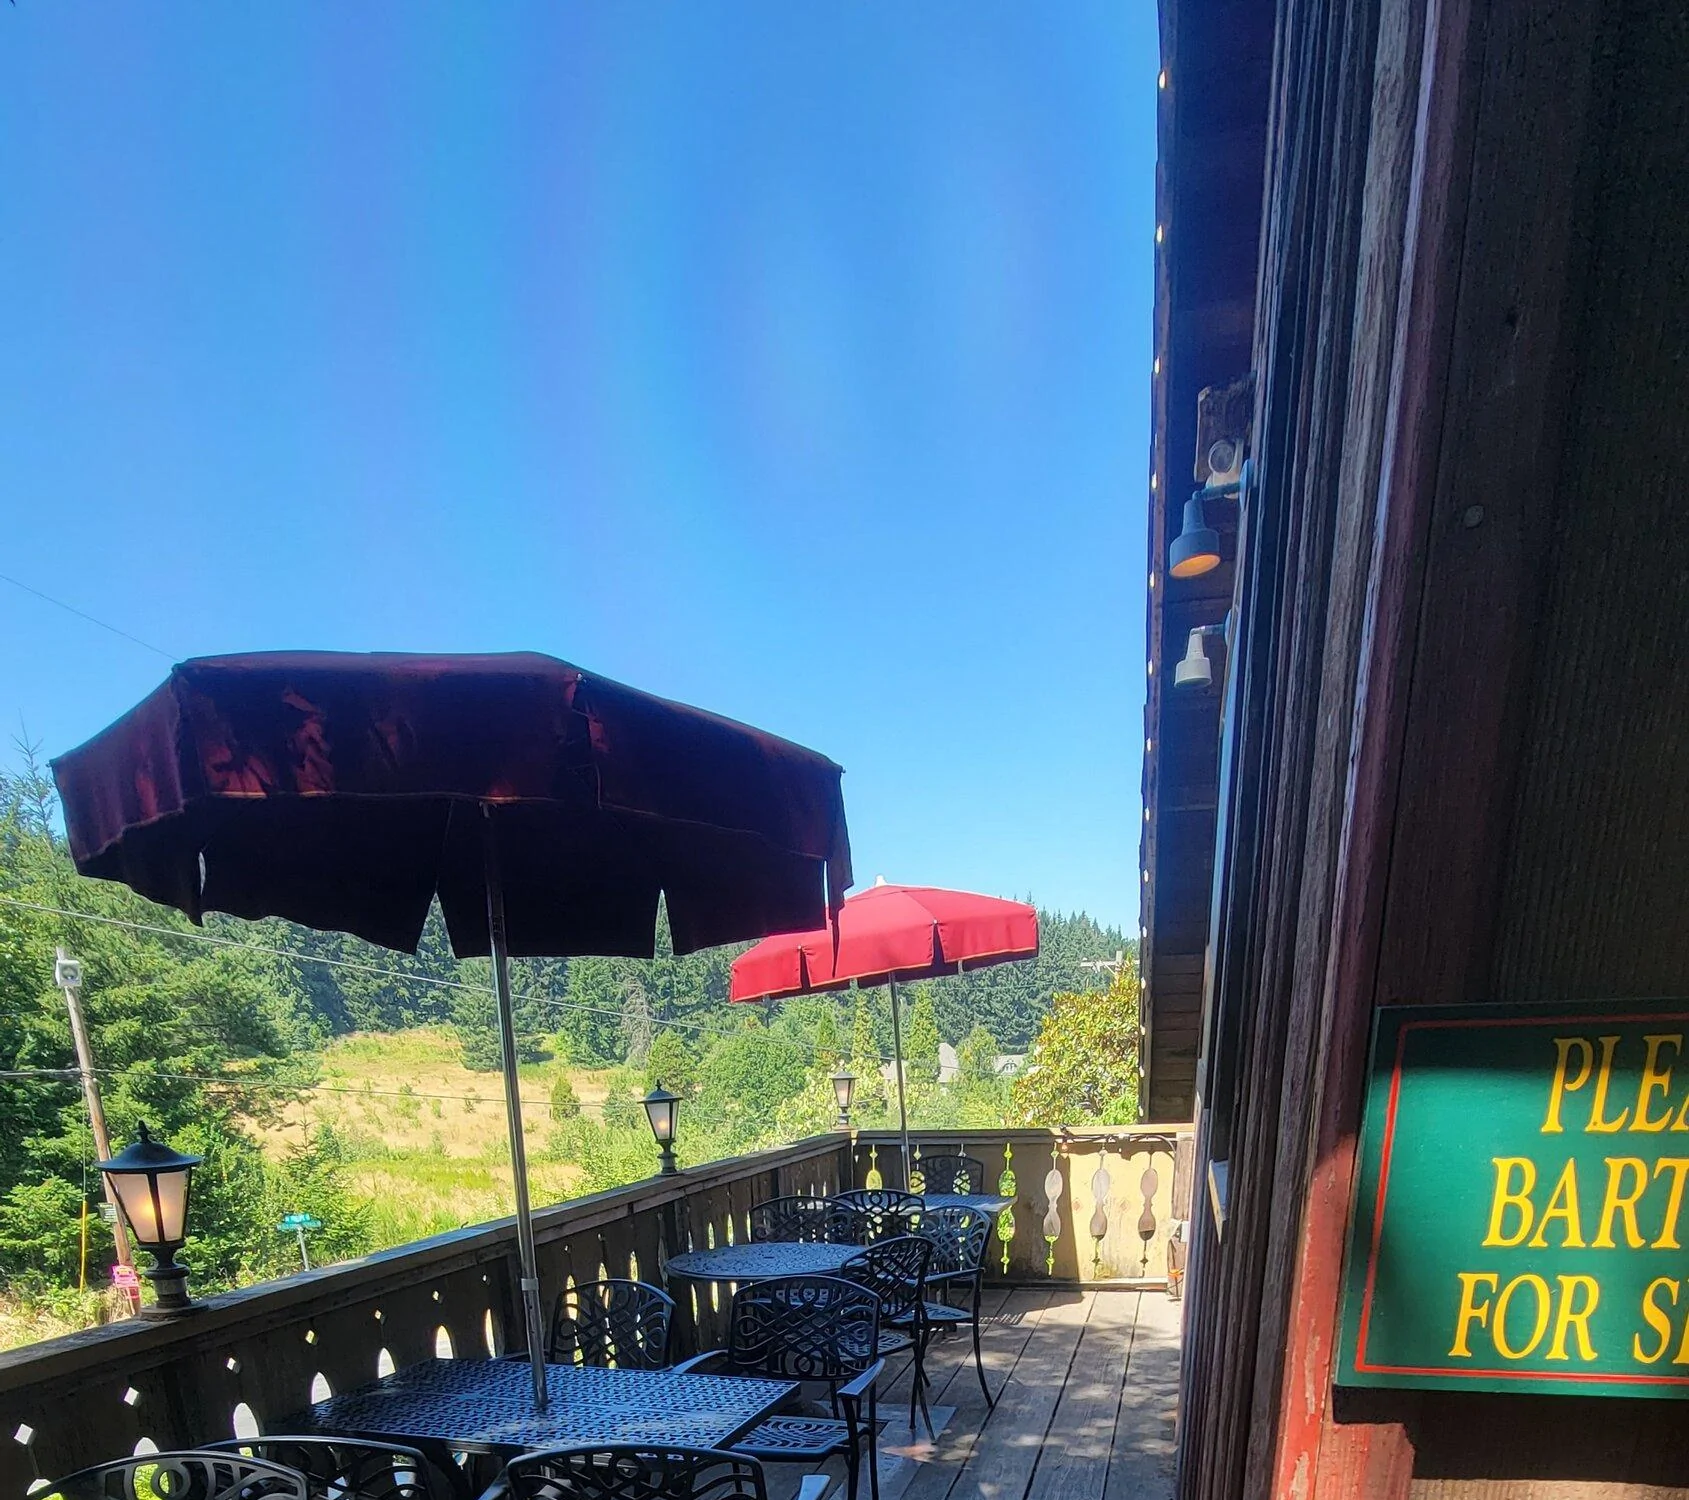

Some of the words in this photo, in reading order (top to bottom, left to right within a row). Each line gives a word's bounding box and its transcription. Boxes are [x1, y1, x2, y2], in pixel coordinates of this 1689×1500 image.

[1541, 1034, 1689, 1133] PLE
[1482, 1156, 1689, 1249] BART
[1448, 1273, 1599, 1362] FOR
[1633, 1277, 1689, 1365] S
